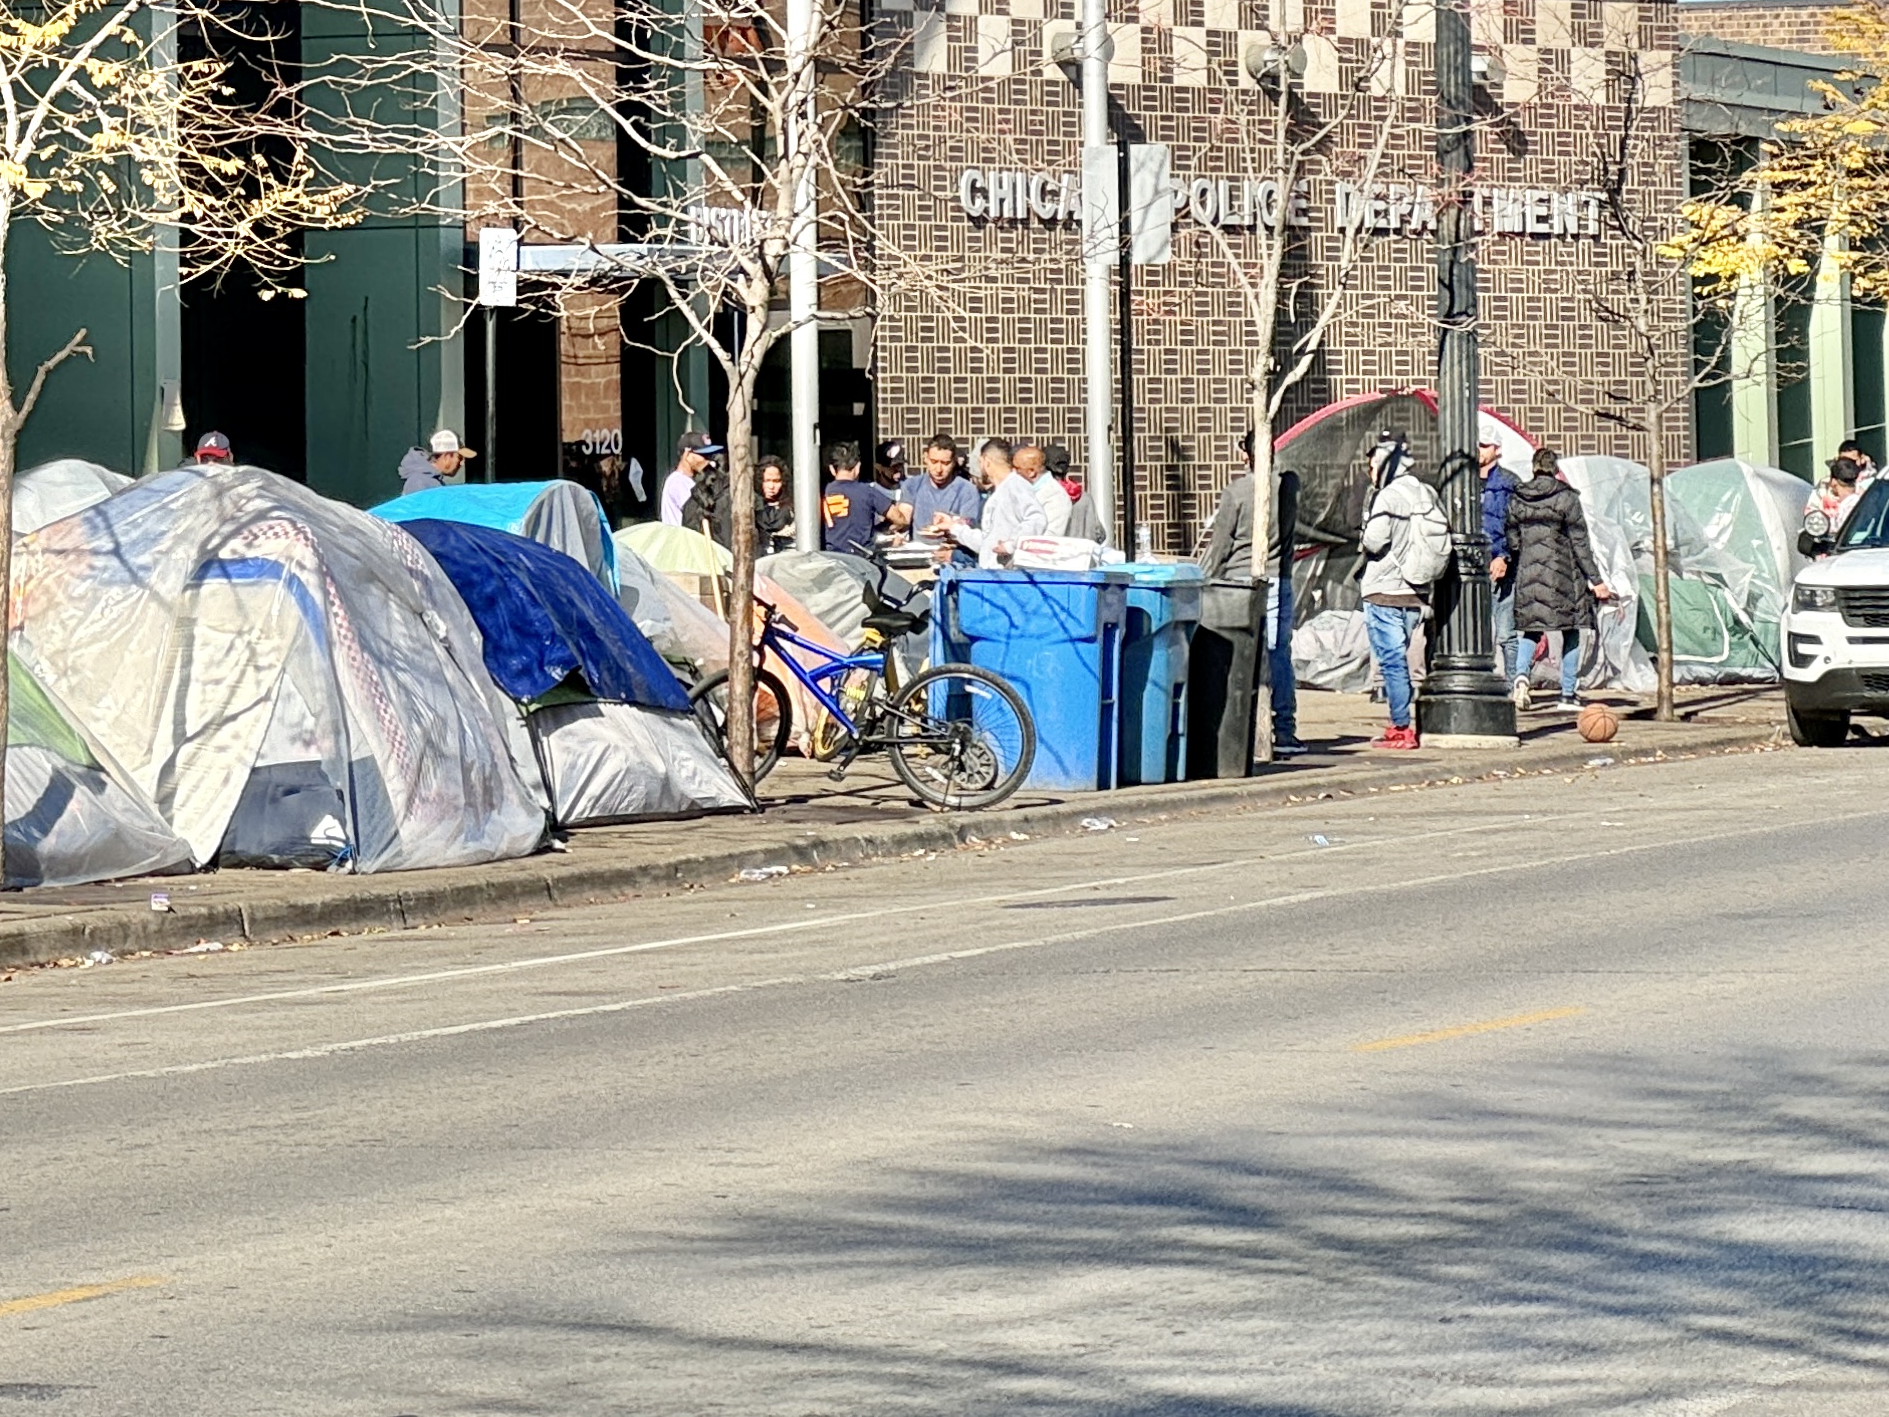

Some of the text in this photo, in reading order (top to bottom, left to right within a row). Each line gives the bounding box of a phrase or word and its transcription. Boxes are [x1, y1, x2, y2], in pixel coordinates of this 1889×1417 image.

[960, 169, 1083, 220] CHICA
[1336, 182, 1607, 234] DEPATMENT
[581, 428, 623, 455] 3120
